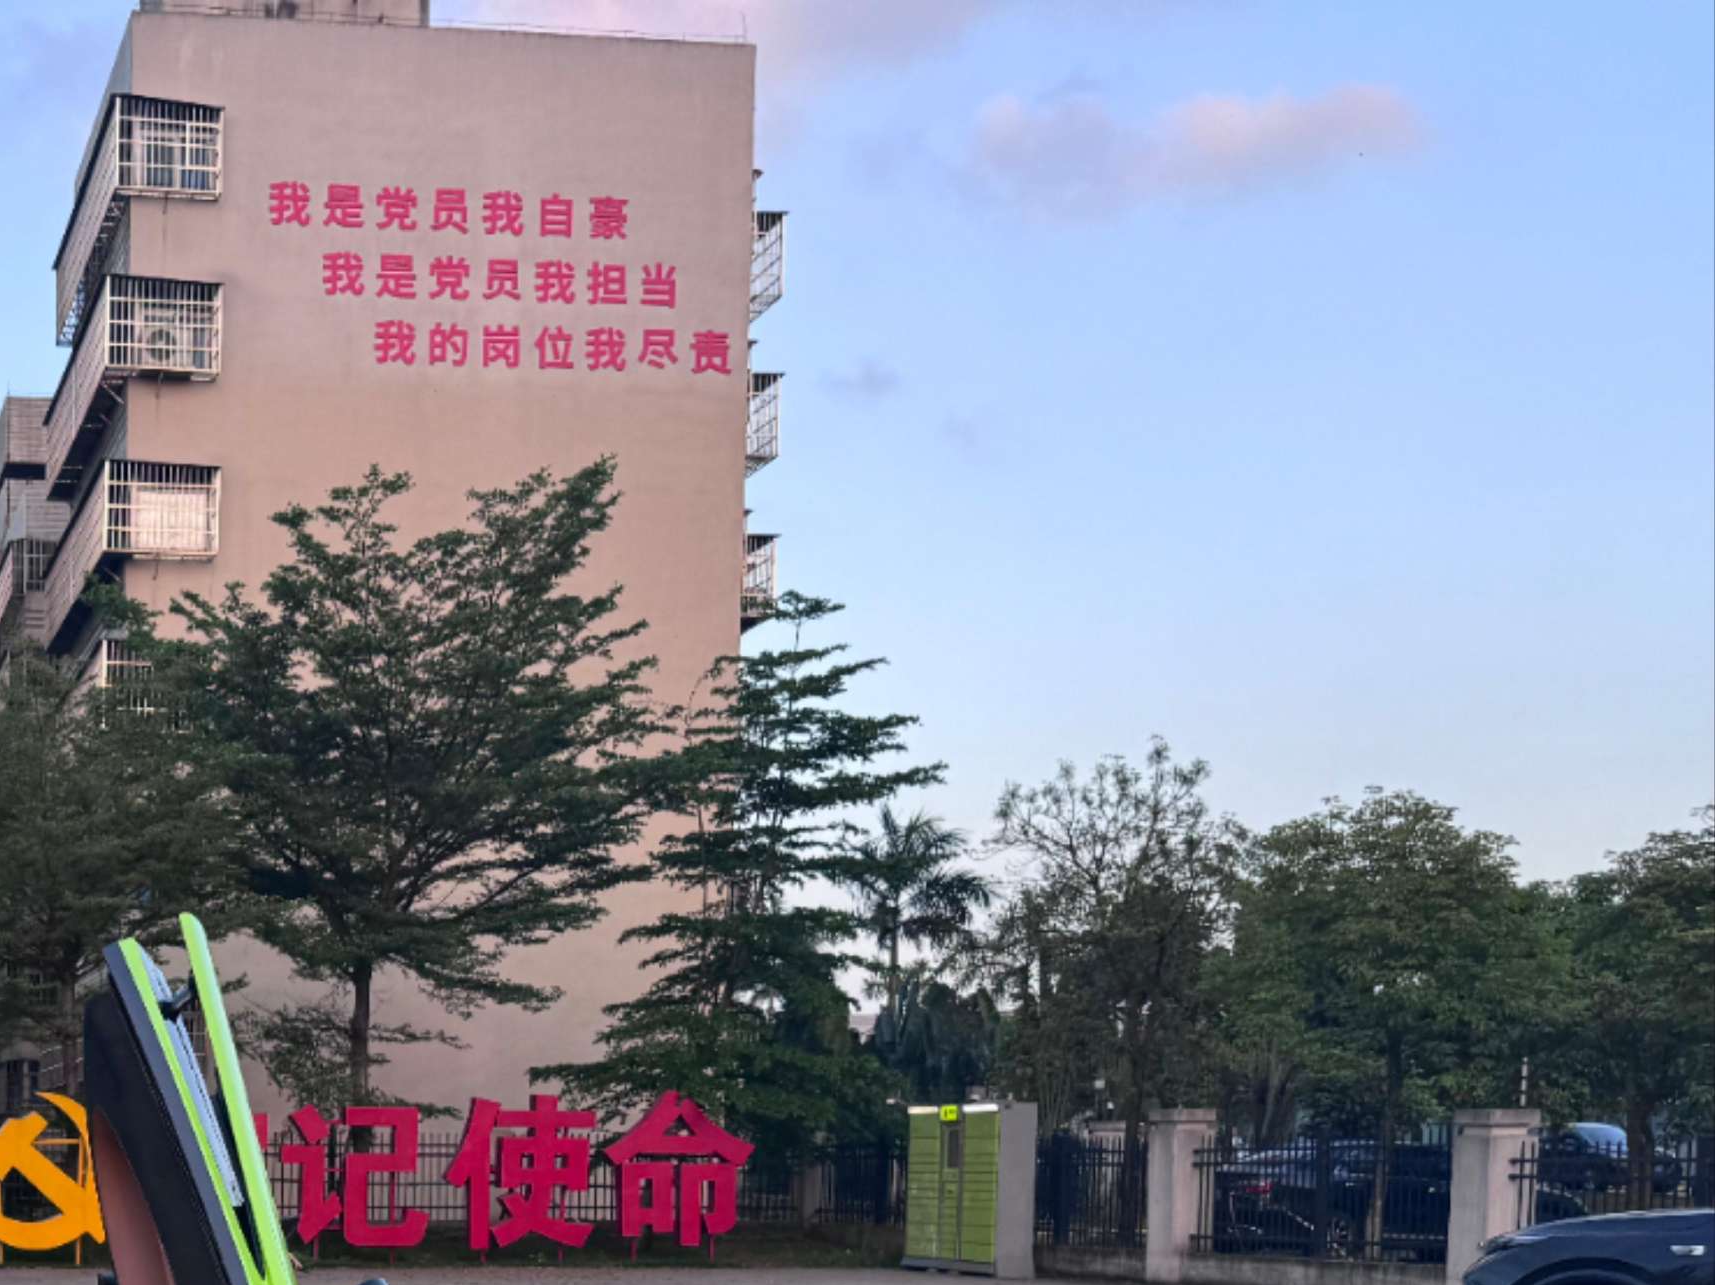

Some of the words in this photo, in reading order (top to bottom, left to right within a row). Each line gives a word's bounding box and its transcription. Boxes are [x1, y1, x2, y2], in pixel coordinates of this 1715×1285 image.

[268, 180, 629, 241] 我是党员我自豪
[321, 251, 678, 310] 我是党员我担当
[373, 319, 732, 375] 我的岗位我尽责
[253, 1090, 755, 1250] 记使命
